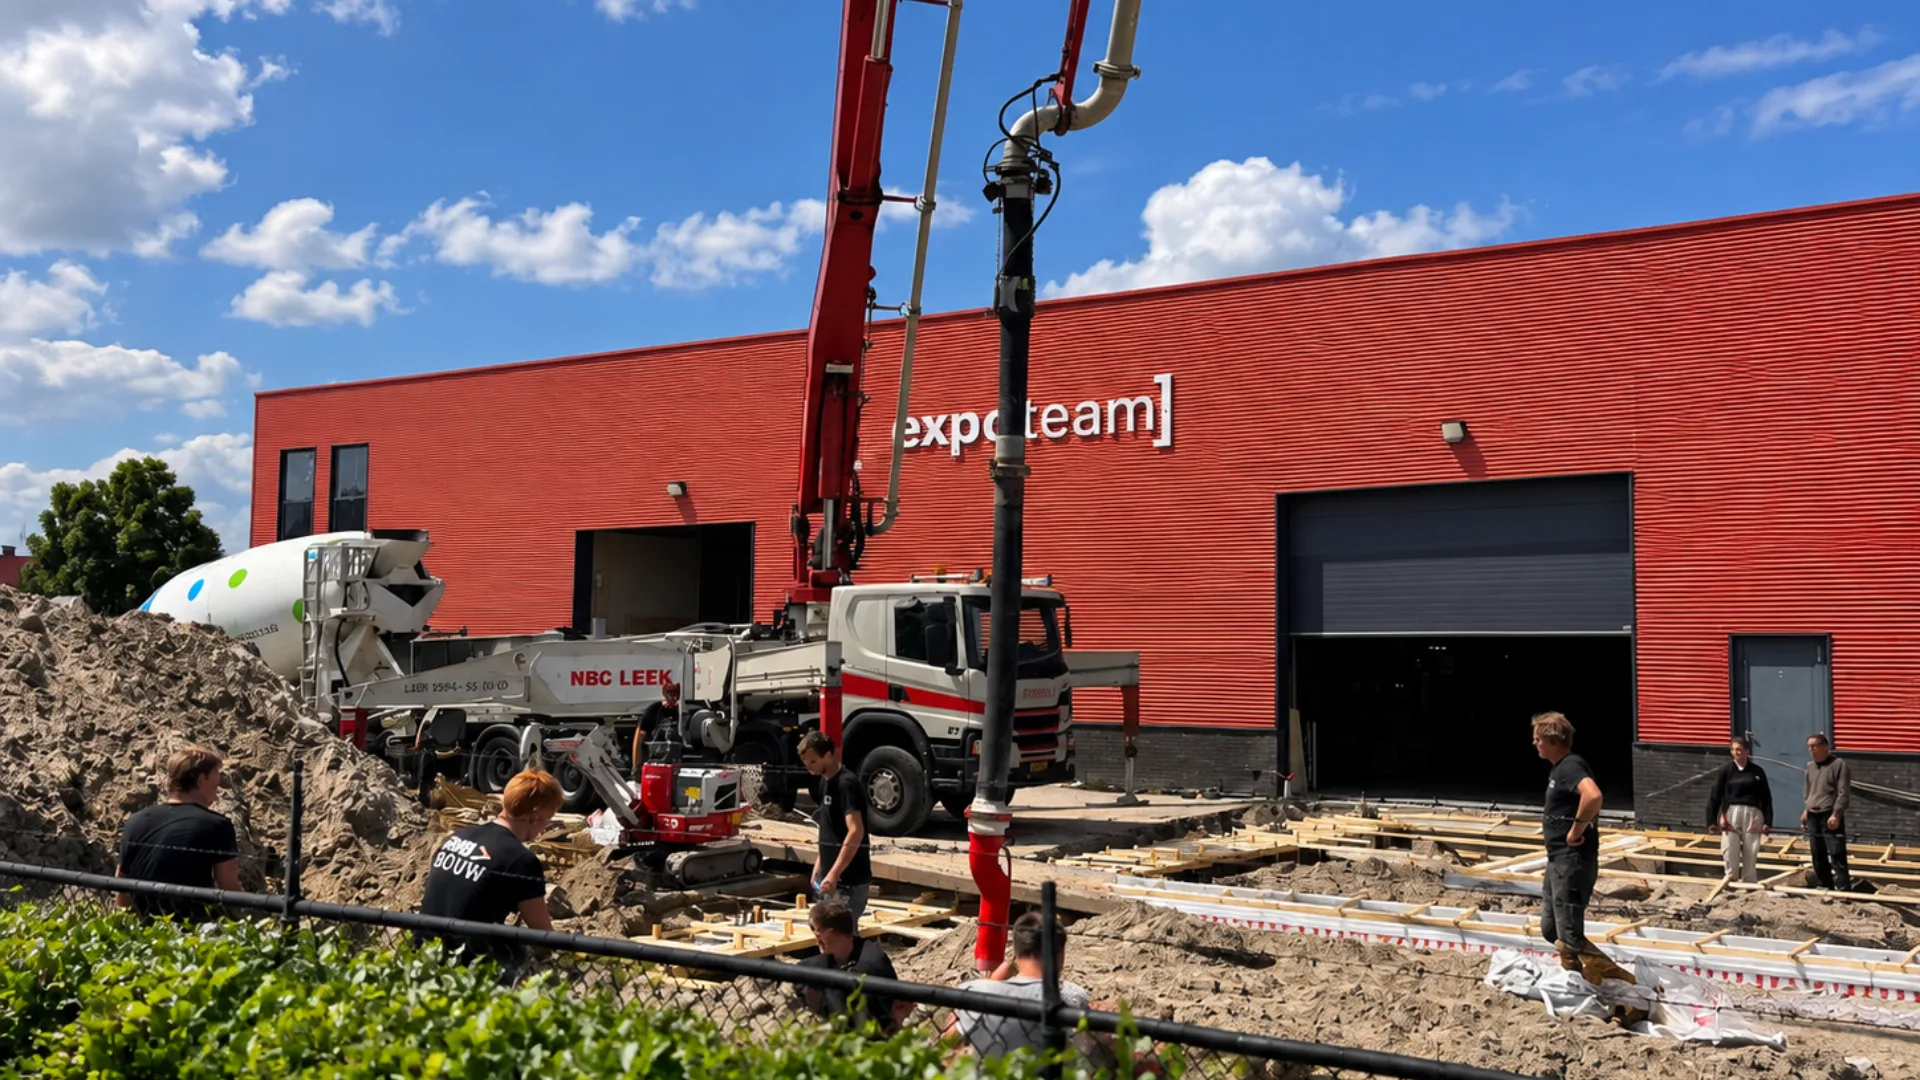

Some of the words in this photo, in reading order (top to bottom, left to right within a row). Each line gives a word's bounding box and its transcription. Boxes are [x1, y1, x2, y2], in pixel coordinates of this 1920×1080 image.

[570, 669, 612, 687] NBC
[619, 669, 673, 687] LEEK
[433, 851, 487, 882] BOUW
